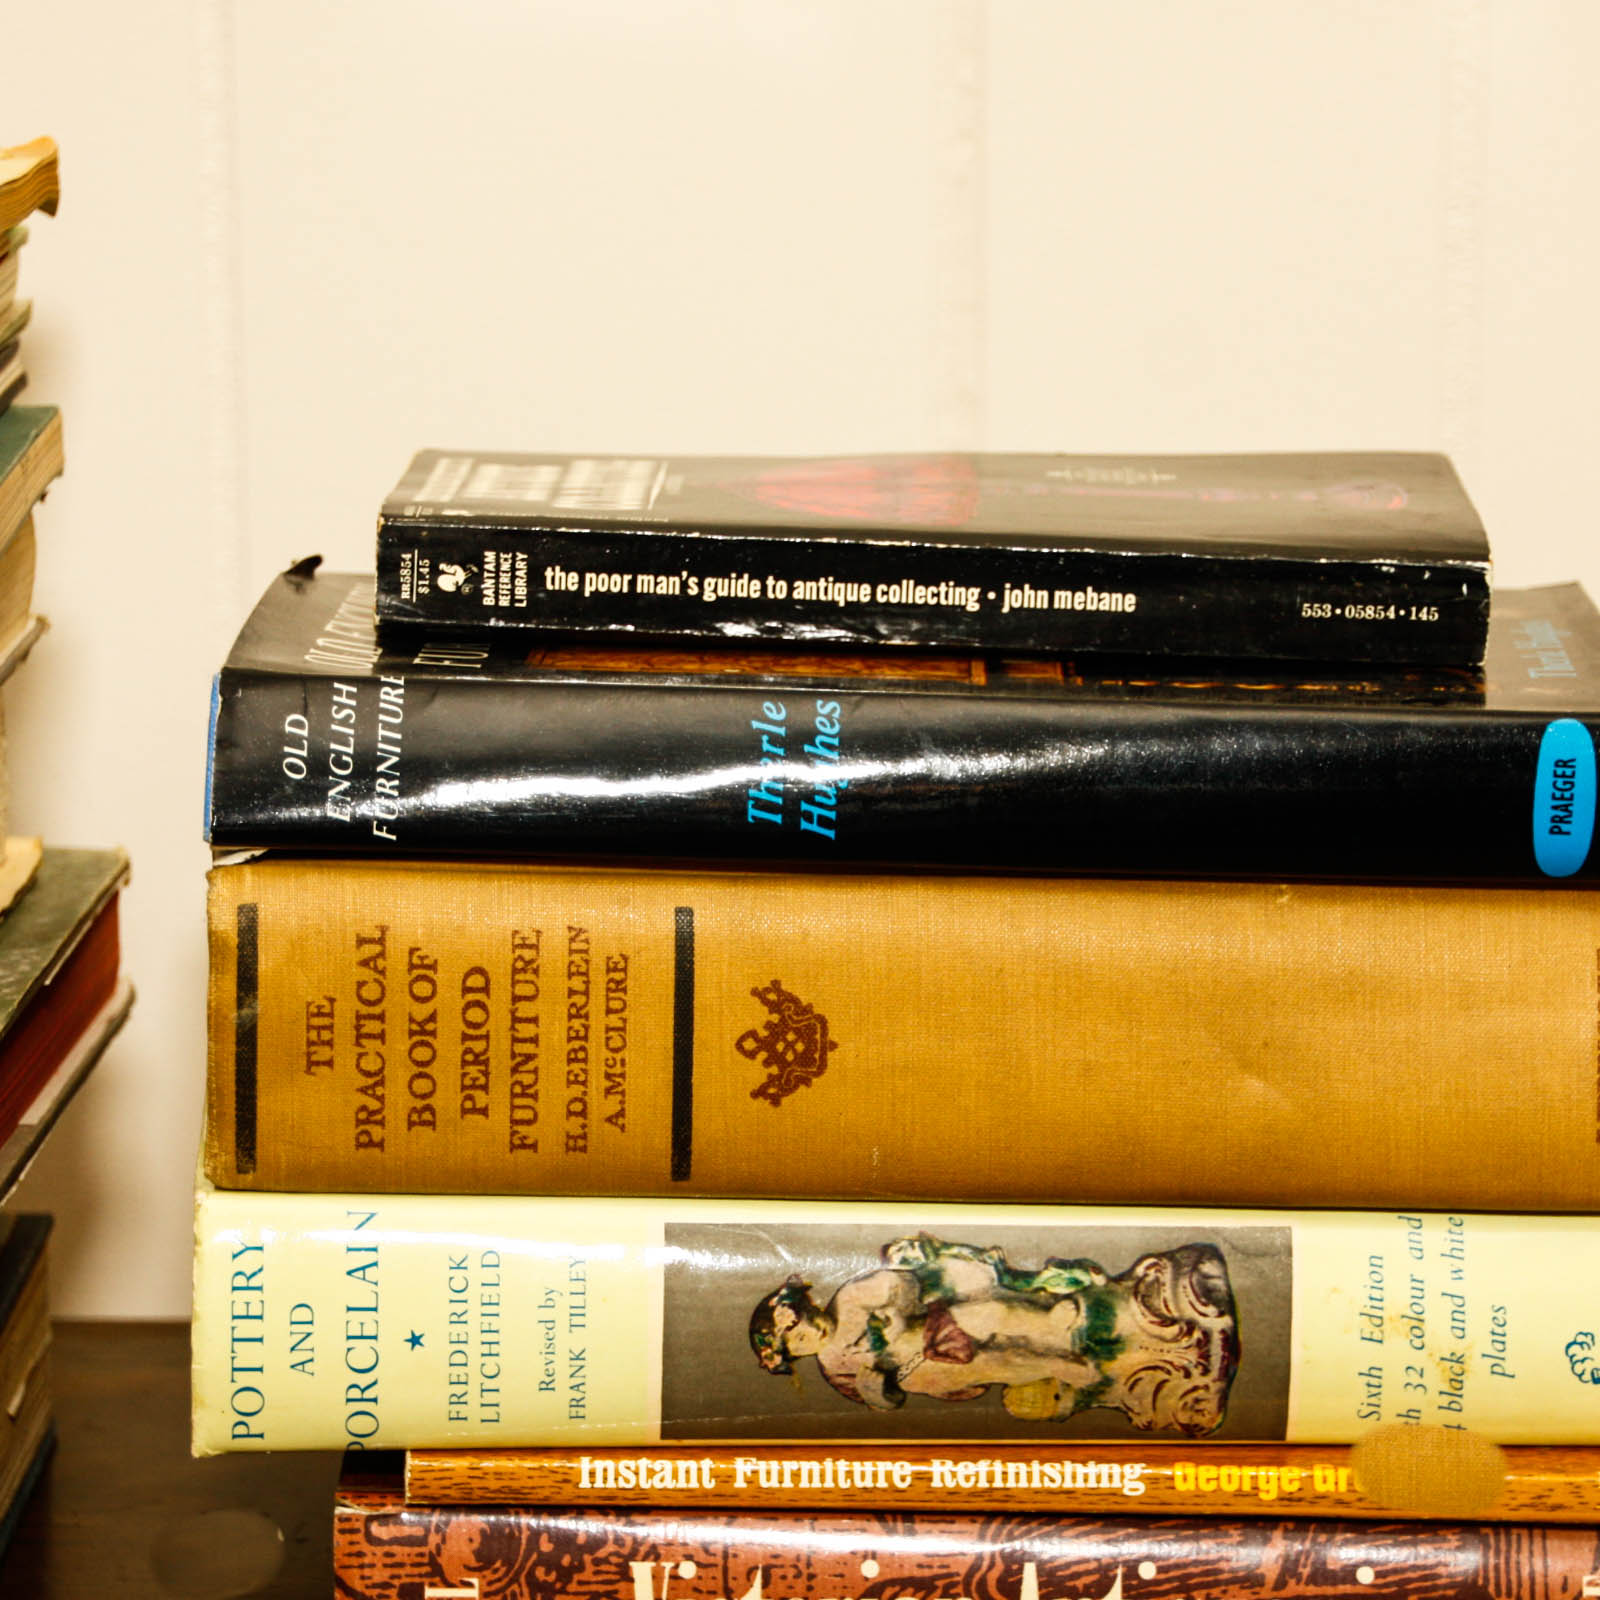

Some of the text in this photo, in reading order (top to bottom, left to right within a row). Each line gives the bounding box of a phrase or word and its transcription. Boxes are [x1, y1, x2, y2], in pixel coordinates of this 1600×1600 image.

[400, 553, 412, 599] RR5854
[418, 559, 430, 594] $1.45
[482, 551, 496, 606] BANTAM
[498, 552, 512, 607] REFERENCE
[514, 551, 528, 607] LIBRARY
[544, 565, 1137, 613] the poor man's guide to antique collecting john mebane
[283, 713, 308, 780] OLD
[327, 682, 357, 823] ENGLISH
[1549, 758, 1576, 836] PRAEGER
[304, 995, 336, 1076] THE
[353, 925, 389, 1152] PRACTICAL
[408, 947, 438, 1131] BOOK OF
[460, 966, 491, 1120] PERIOD
[509, 929, 543, 1154] FURNITURE
[1398, 1215, 1424, 1260] and
[1440, 1216, 1465, 1281] white
[230, 1238, 265, 1440] POTTERY
[289, 1303, 314, 1376] AND
[448, 1254, 469, 1421] FREDERICK
[480, 1250, 501, 1423] LITCHFIELD
[538, 1287, 563, 1392] Revised by
[569, 1256, 586, 1420] FRANK TILLEY
[1357, 1255, 1385, 1422] Sixth Edition
[1401, 1274, 1425, 1351] colour
[1441, 1292, 1466, 1340] and
[1481, 1304, 1515, 1379] plates
[1405, 1365, 1427, 1395] 32
[1438, 1351, 1465, 1413] black
[578, 1456, 715, 1489] Instant
[734, 1457, 912, 1489] Furniture
[931, 1459, 1146, 1496] Refinishing
[1174, 1462, 1301, 1500] George
